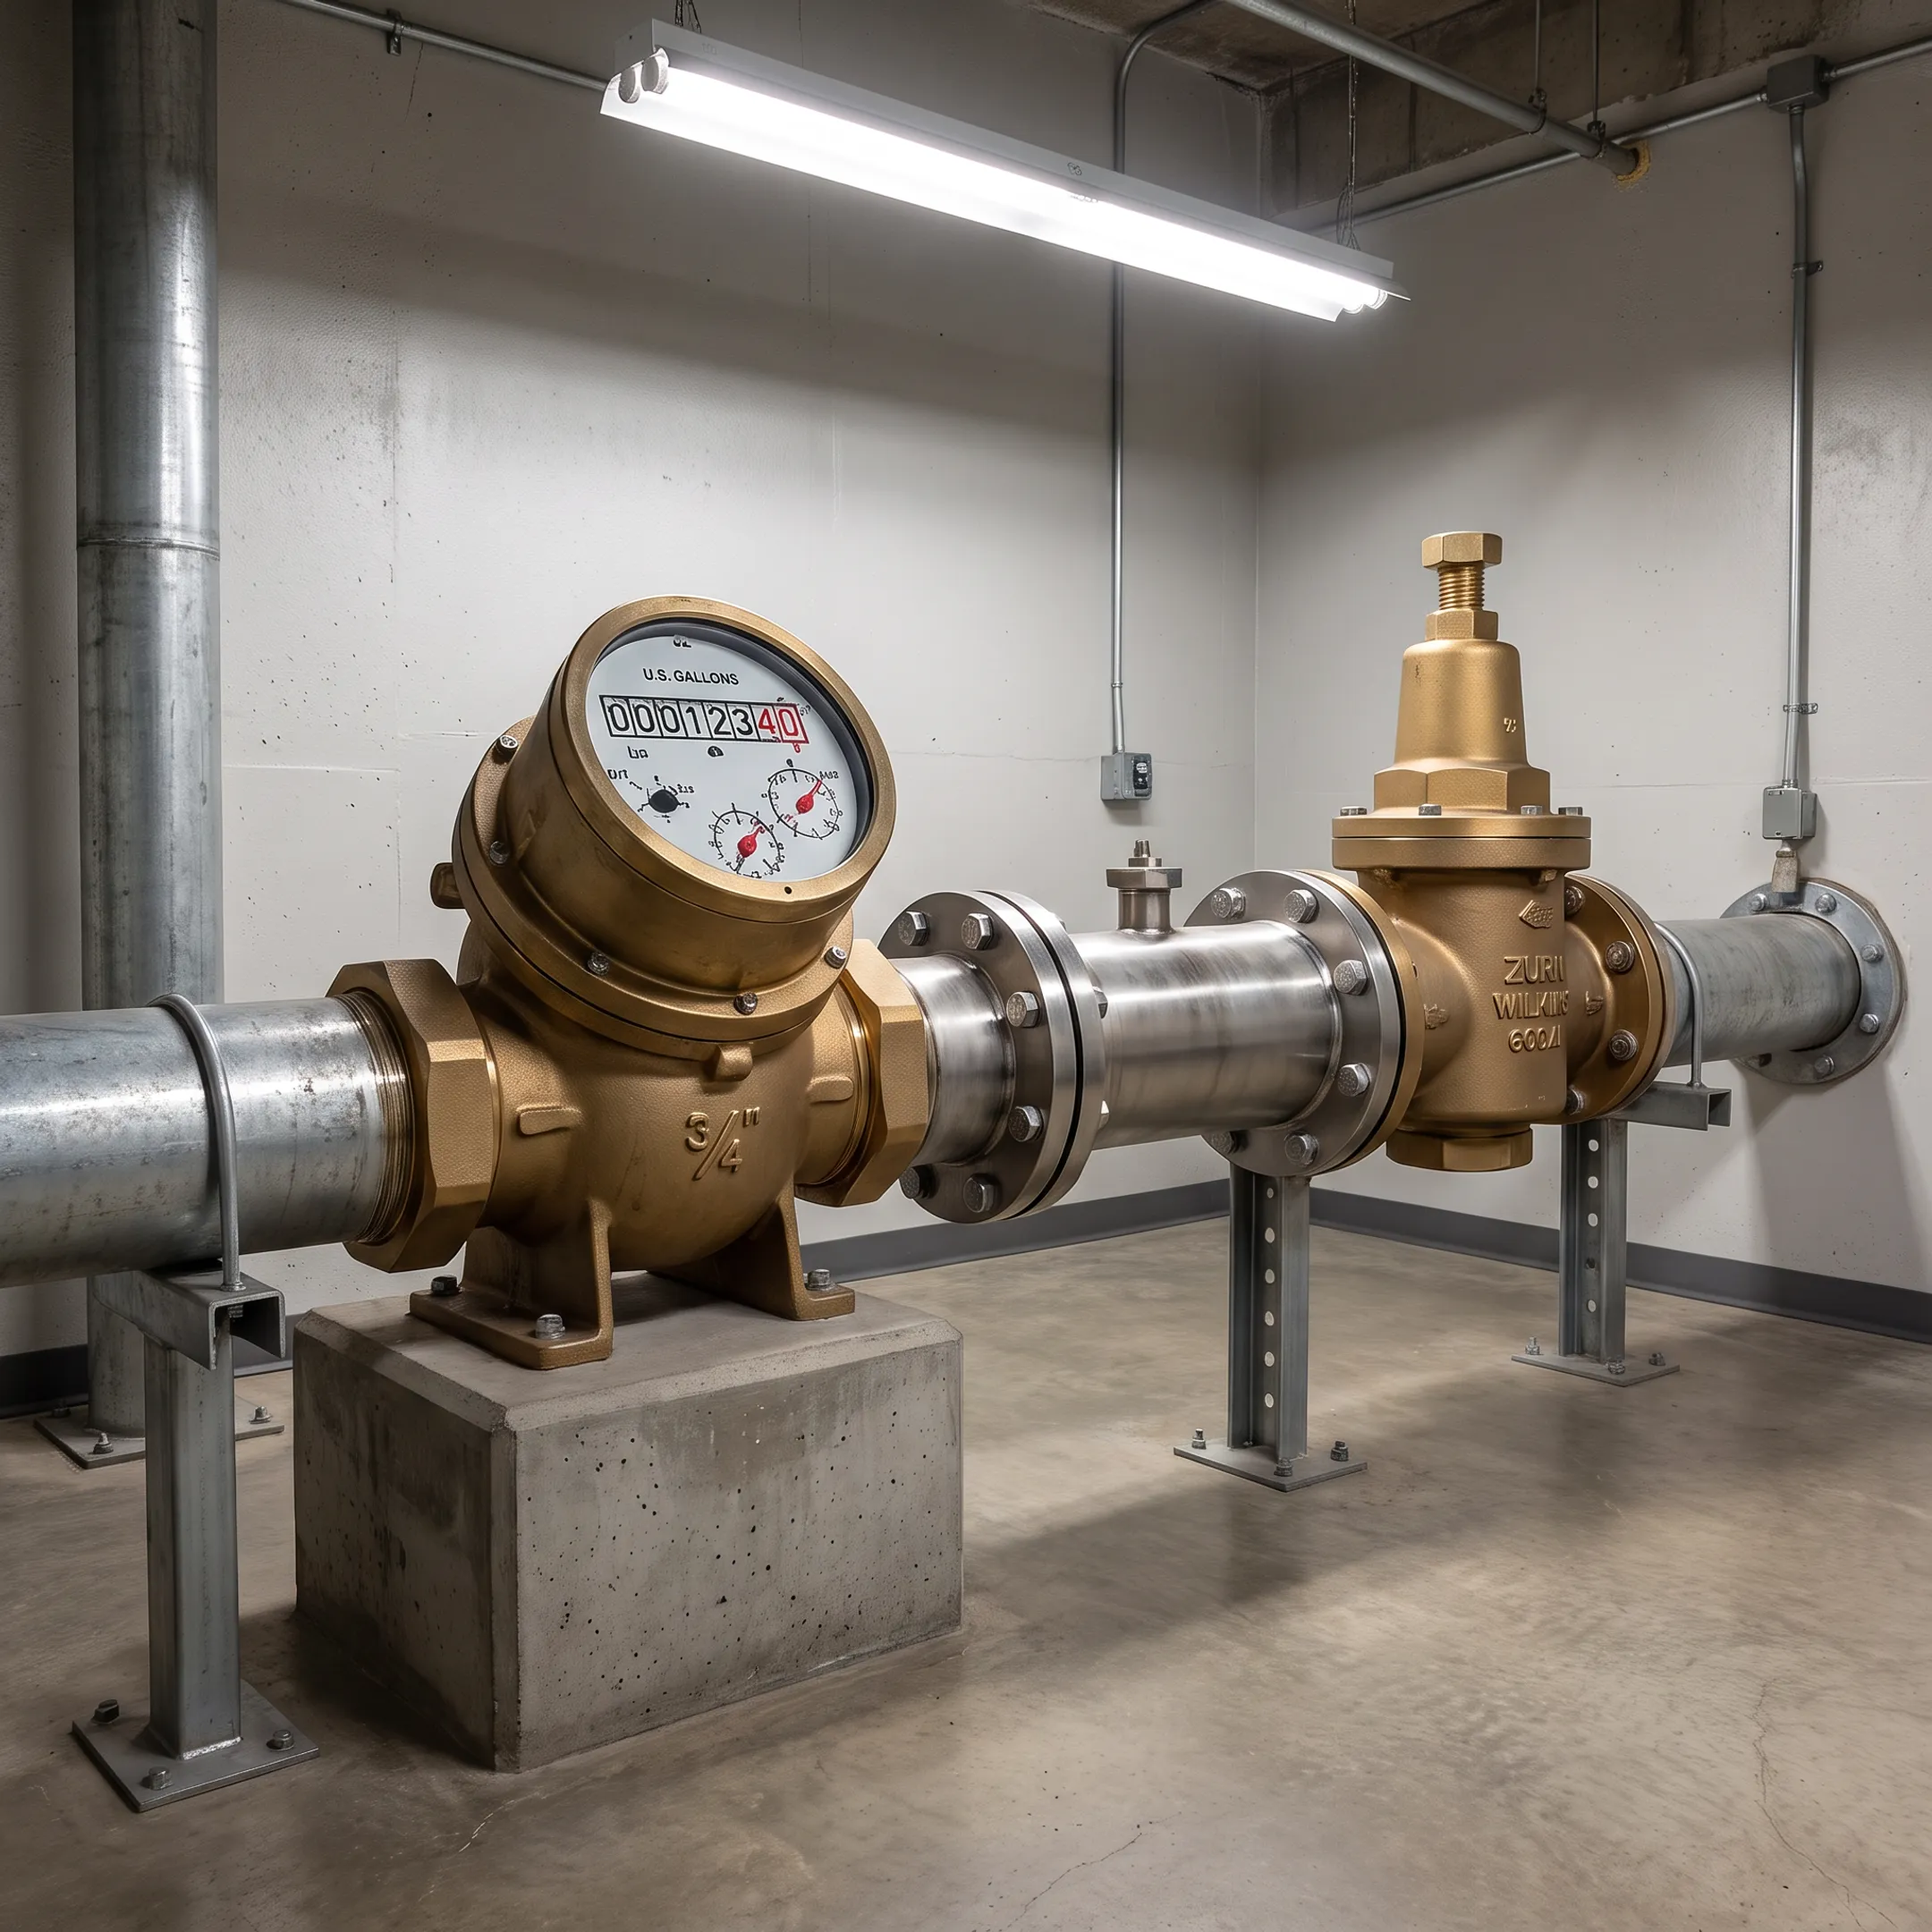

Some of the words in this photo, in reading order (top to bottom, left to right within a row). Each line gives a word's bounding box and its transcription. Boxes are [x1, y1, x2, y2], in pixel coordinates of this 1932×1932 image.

[642, 668, 672, 682] U.S.
[674, 670, 739, 685] GALLONS
[608, 702, 800, 737] 00012340
[685, 1106, 760, 1182] 3/4"
